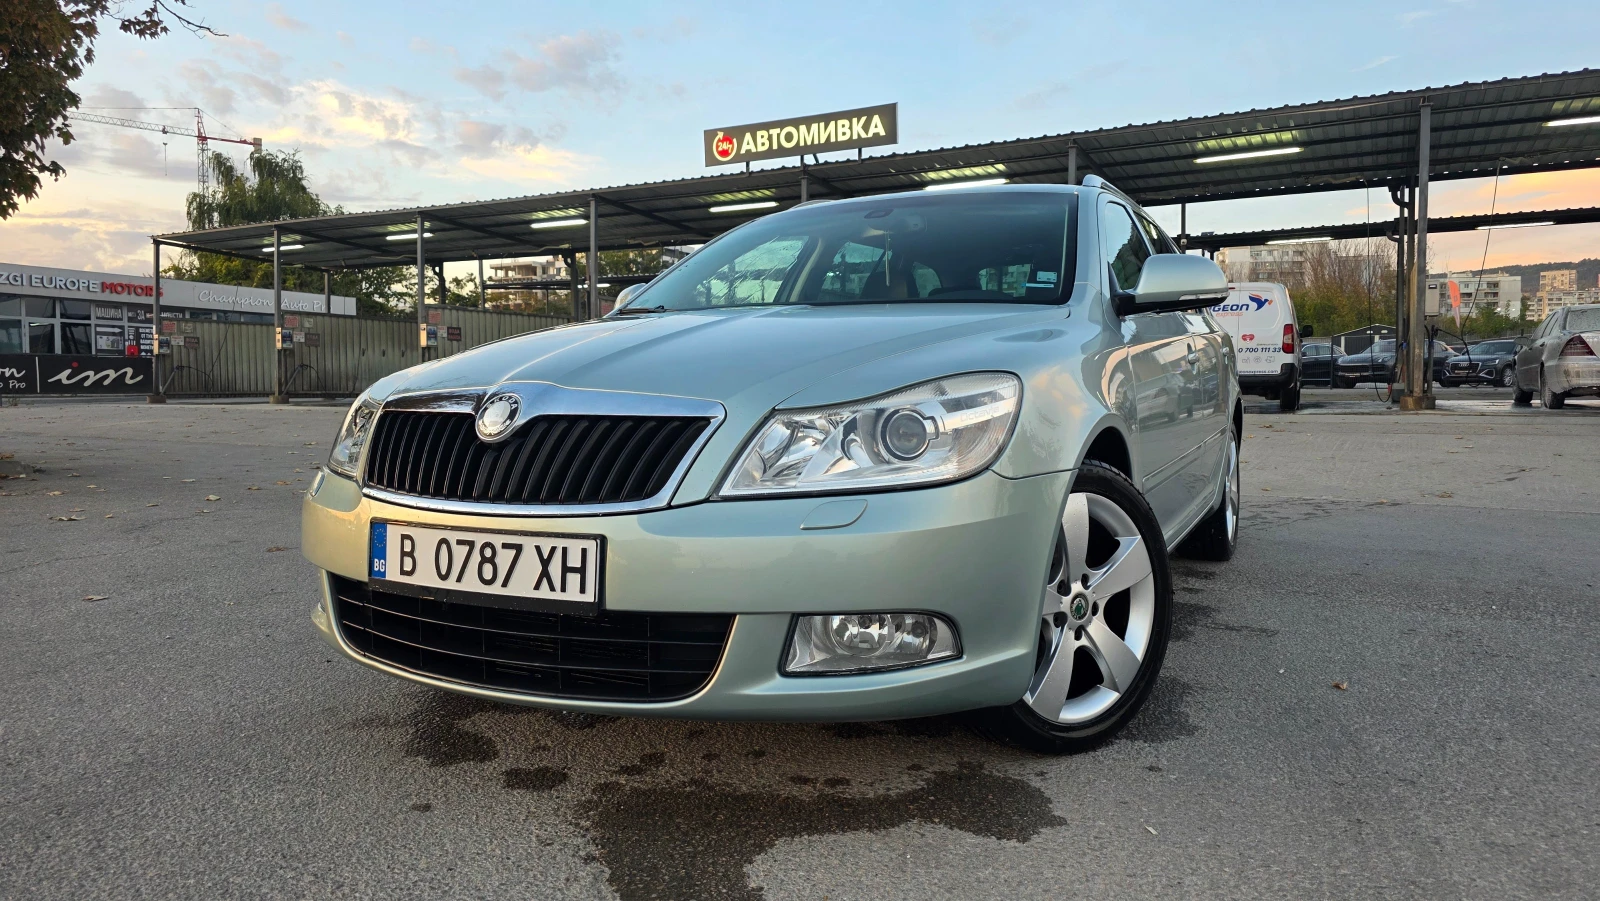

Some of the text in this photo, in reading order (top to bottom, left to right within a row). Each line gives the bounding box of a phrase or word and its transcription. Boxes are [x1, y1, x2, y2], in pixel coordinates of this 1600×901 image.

[740, 114, 886, 154] АВТОМИВКА
[0, 271, 27, 287] ZGI
[30, 274, 100, 292] EUROPE
[198, 289, 333, 312] Champion Auto Pr
[8, 380, 26, 389] Pro
[373, 533, 588, 594] BG B 0787 XH
